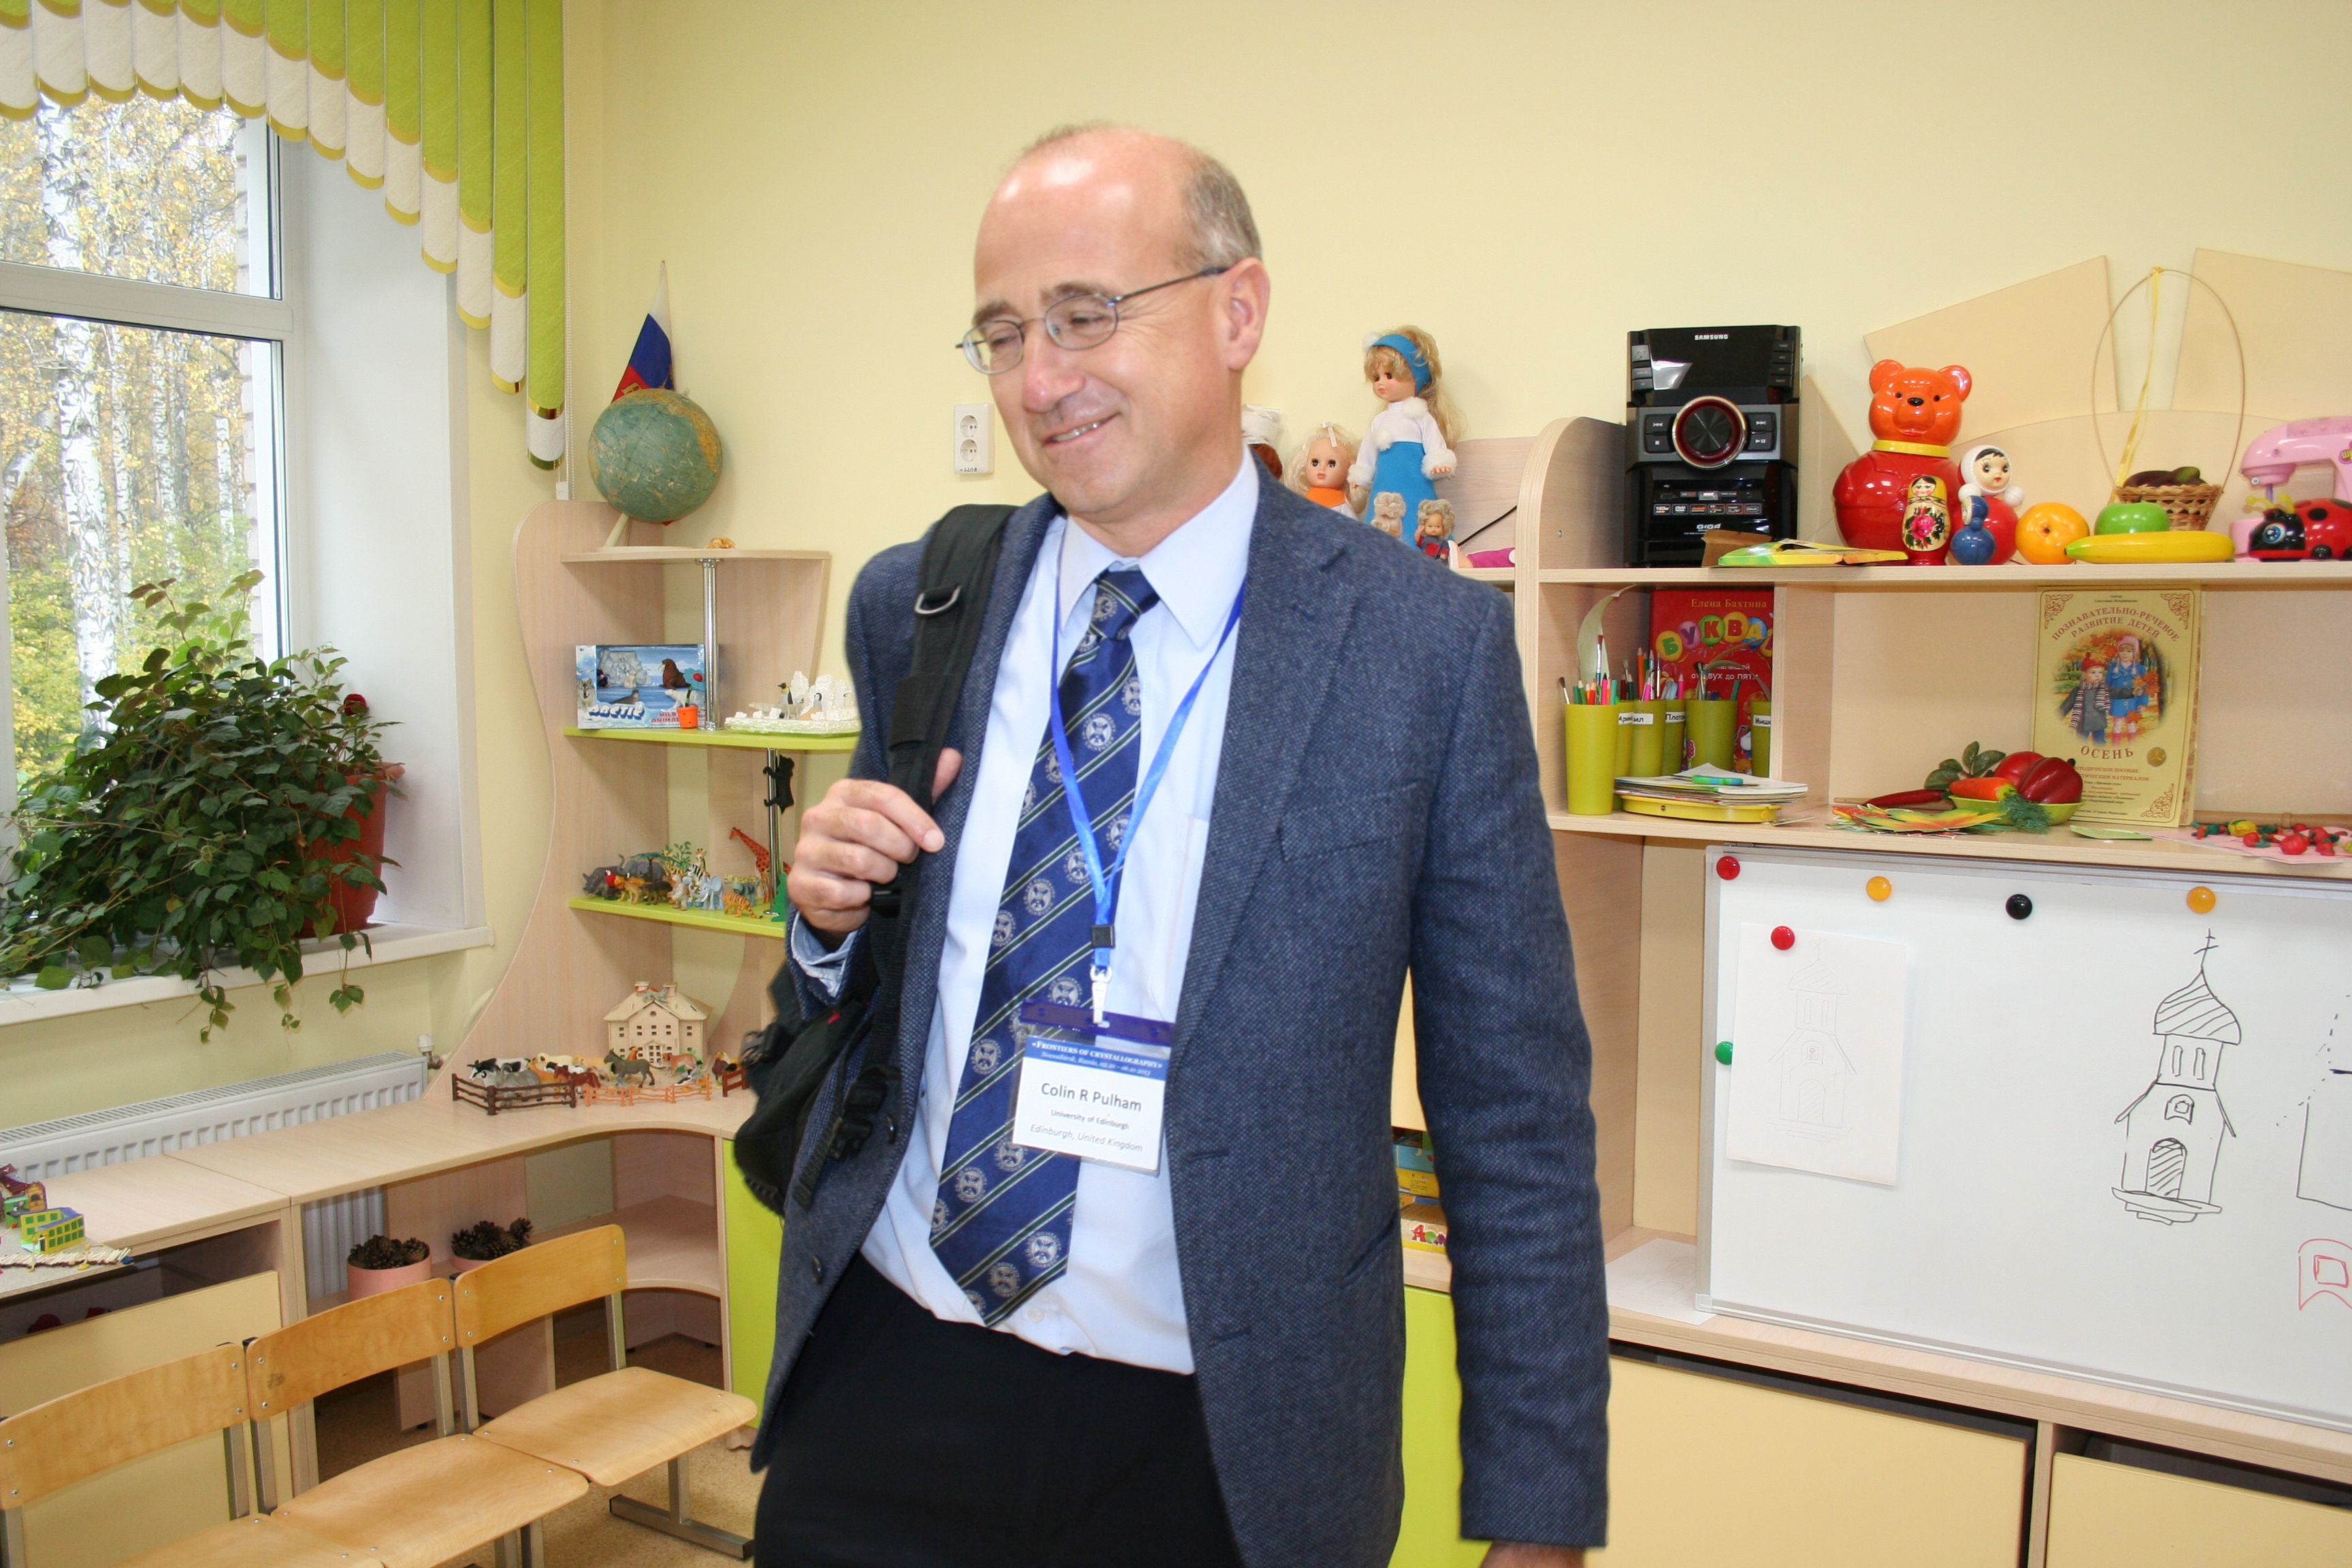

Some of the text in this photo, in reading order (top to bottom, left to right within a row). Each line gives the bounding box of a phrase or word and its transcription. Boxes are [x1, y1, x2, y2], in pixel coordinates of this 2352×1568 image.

[1691, 598, 1767, 608] Елена Бахтина
[2051, 606, 2180, 642] ПОЗНАВАТЕЛЬНО-РЕЧЕВОЕ
[2070, 617, 2161, 639] РАЗВИТИЕ ДЕТЕЙ
[1661, 619, 1774, 656] БУКВА
[1706, 672, 1722, 681] вух
[588, 701, 646, 721] ARCTIC
[2080, 745, 2134, 760] ОСЕНЬ
[1041, 1083, 1142, 1111] Colin R Pulham
[1051, 1109, 1085, 1122] University
[1096, 1117, 1130, 1130] Edinburgh
[1030, 1124, 1143, 1152] Edinburgh, United Kingdom
